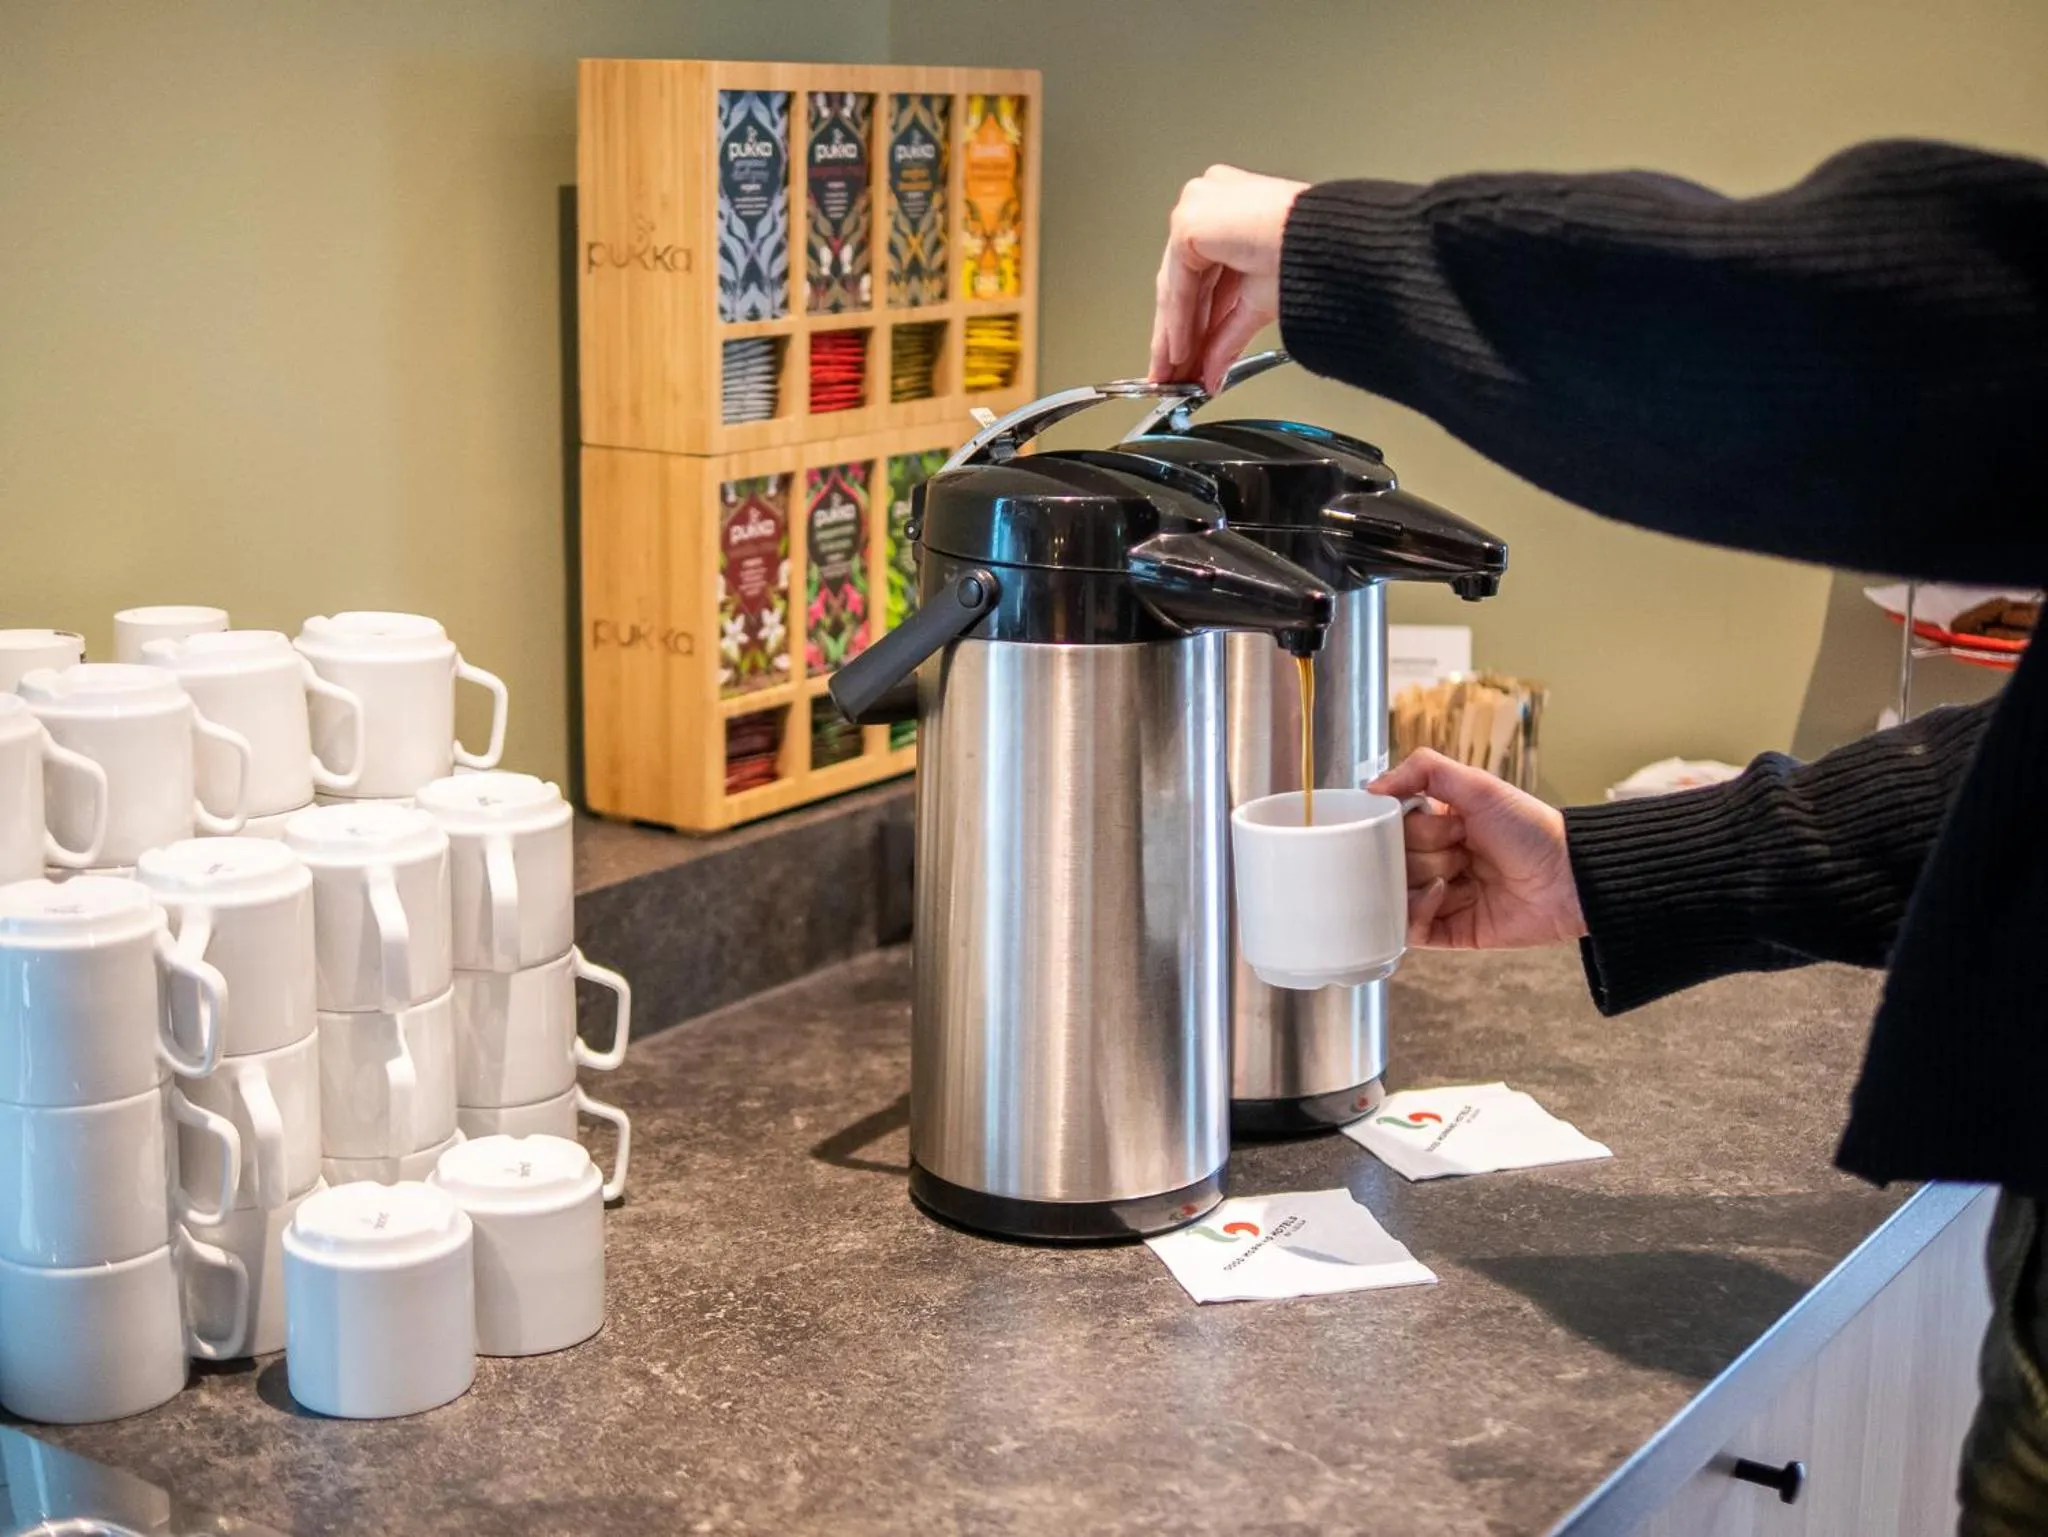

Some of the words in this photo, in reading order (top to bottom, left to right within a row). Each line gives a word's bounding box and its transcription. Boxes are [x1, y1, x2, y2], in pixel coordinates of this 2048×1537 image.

[728, 138, 773, 161] pukka
[814, 140, 858, 163] pukka
[587, 233, 693, 275] pukka
